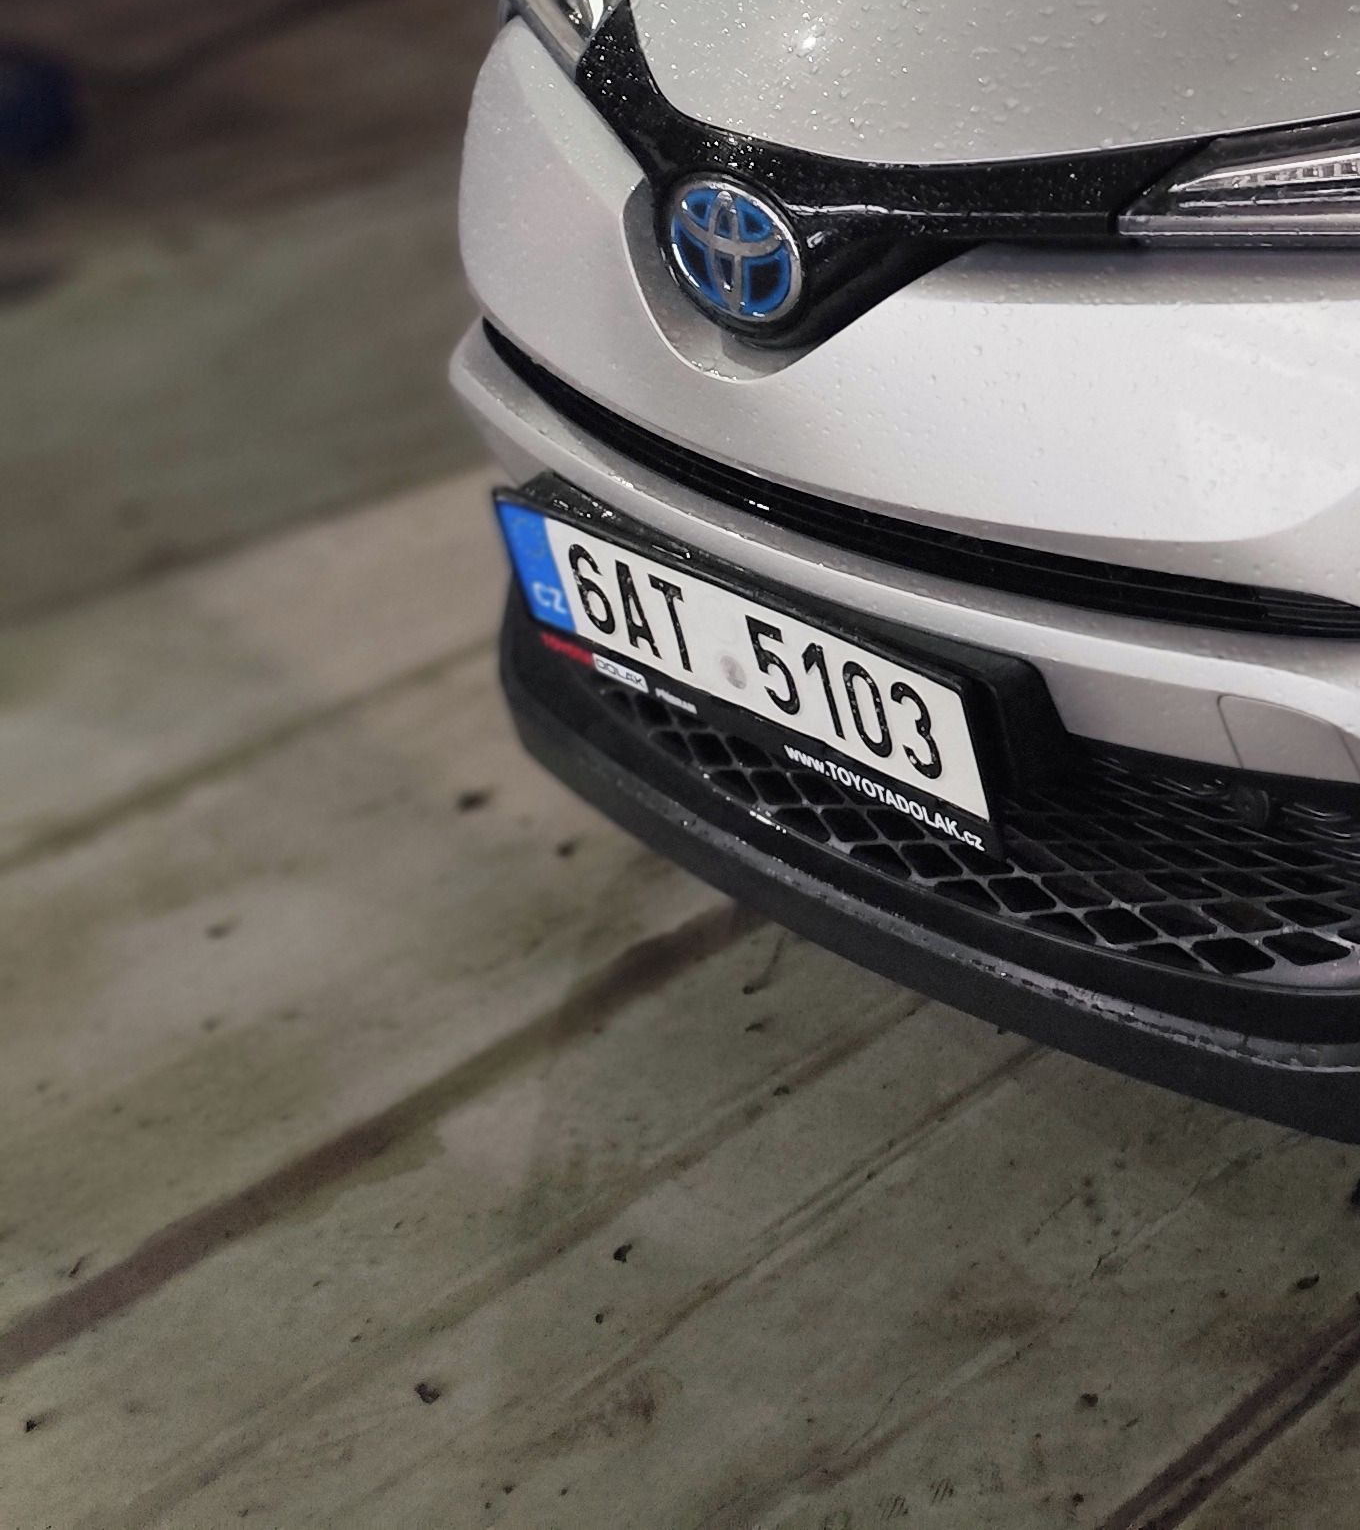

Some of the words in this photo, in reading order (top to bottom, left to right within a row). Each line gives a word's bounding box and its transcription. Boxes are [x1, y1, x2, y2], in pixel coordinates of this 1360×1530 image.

[532, 581, 567, 615] CZ
[568, 543, 694, 673] 6AT
[745, 614, 943, 780] 5103
[783, 744, 986, 852] www.TOYOTADOLAK.cz
